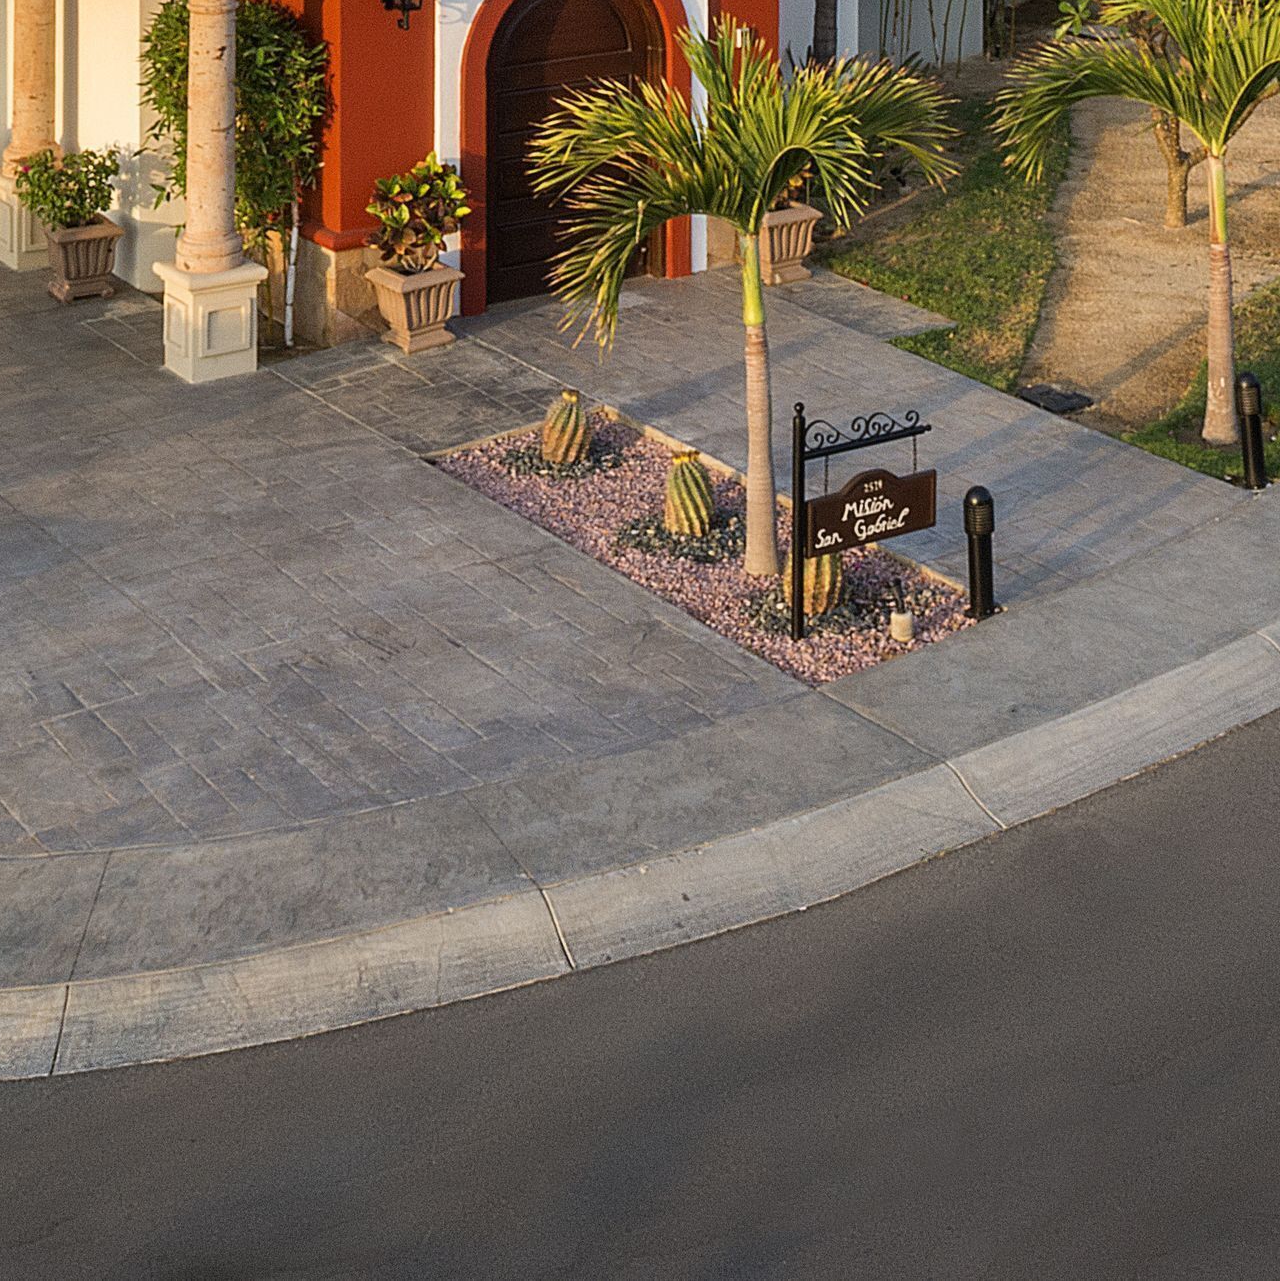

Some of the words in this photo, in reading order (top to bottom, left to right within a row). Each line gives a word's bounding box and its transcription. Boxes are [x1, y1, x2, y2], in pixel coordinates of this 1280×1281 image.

[841, 495, 894, 522] Misión
[815, 528, 843, 549] San
[854, 508, 910, 541] Gabriel
